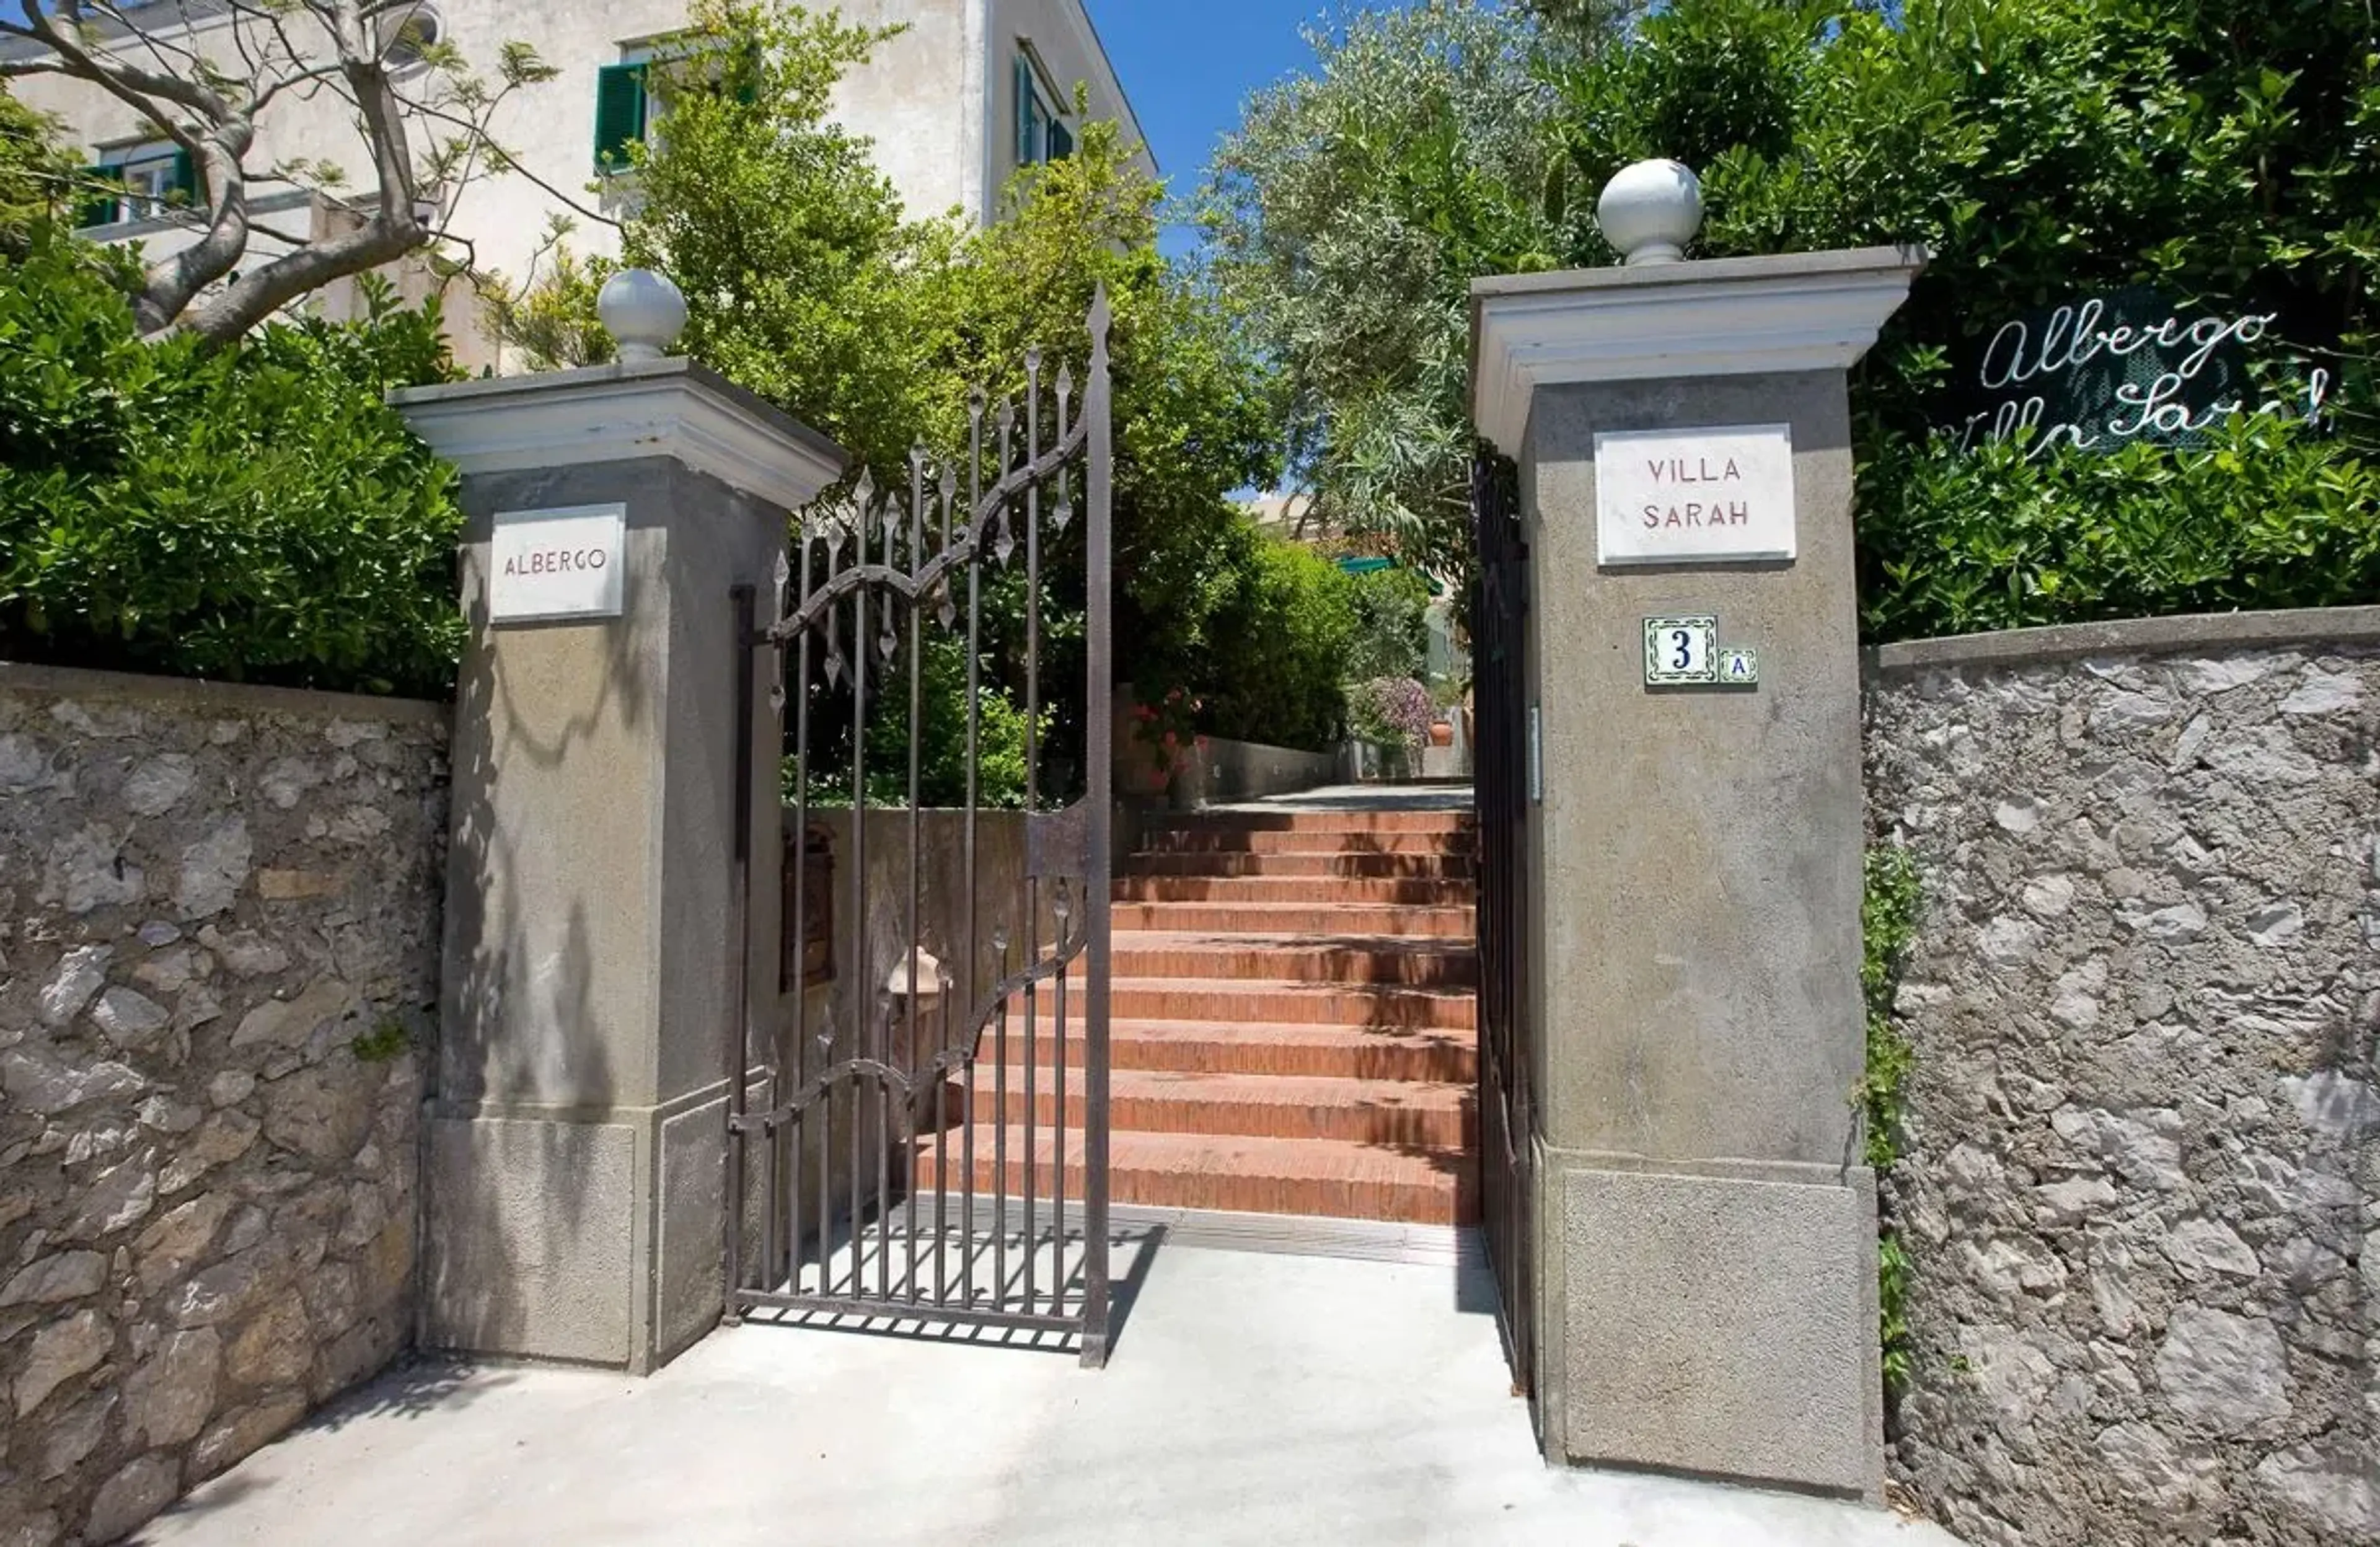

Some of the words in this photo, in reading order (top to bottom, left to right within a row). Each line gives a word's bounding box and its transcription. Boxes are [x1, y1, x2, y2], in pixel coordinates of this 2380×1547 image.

[1980, 298, 2278, 389] Albergo
[1647, 457, 1742, 482] VILLA
[1643, 501, 1748, 529] SARAH
[504, 549, 606, 576] ALBERGO
[1671, 630, 1691, 669] 3
[1731, 656, 1747, 674] A
